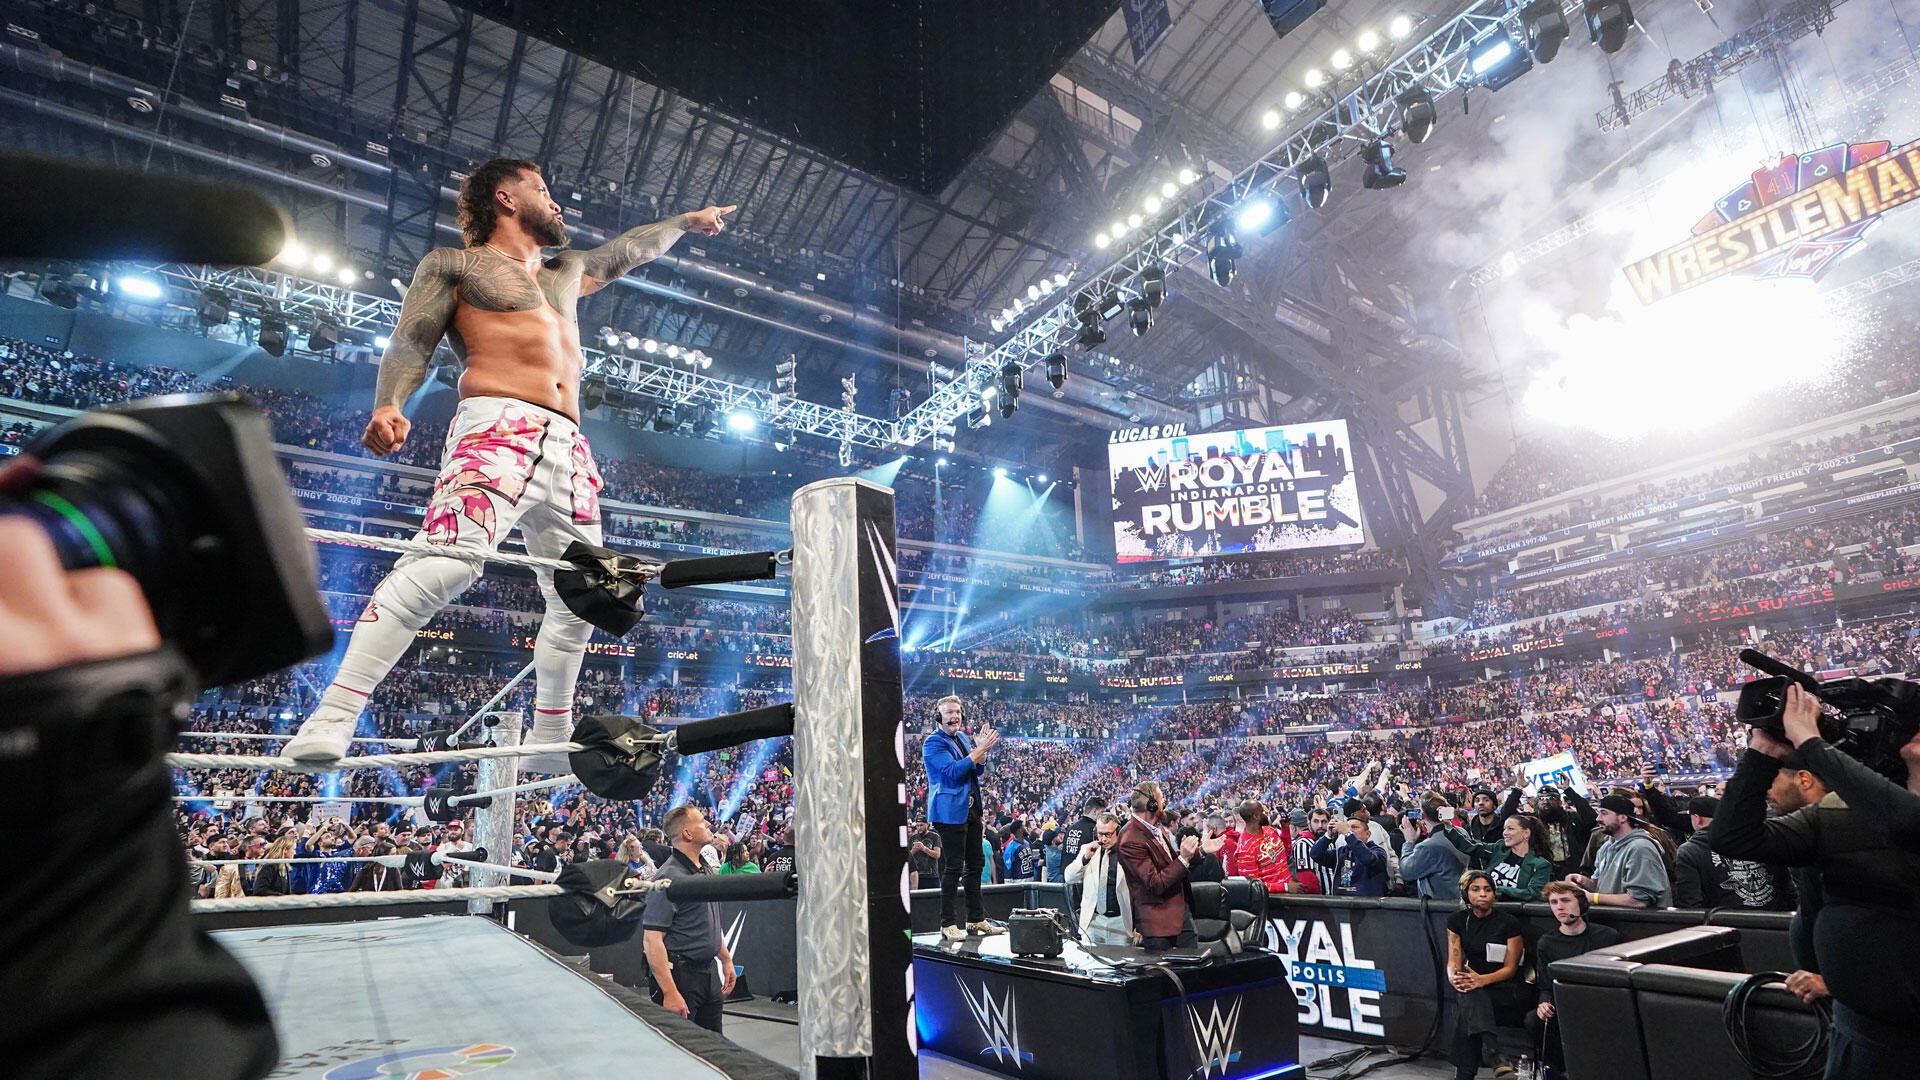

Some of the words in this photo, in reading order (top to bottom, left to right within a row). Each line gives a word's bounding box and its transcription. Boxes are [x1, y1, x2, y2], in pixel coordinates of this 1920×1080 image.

[1109, 425, 1161, 443] LUCAS
[1162, 423, 1187, 438] OIL
[1169, 449, 1321, 492] ROYAL
[1727, 479, 1763, 494] DWIGHT
[1766, 466, 1811, 485] FREENEY
[1817, 455, 1857, 471] 2002-12
[1170, 481, 1295, 502] INDIANAPOLIS
[327, 494, 362, 506] 2002-08
[1142, 489, 1328, 536] RUMBLE
[1587, 515, 1616, 529] ROBERT
[1616, 509, 1646, 522] MATHIS
[607, 536, 632, 546] JAMES
[634, 539, 661, 549] 1999-05
[702, 547, 719, 556] ERIC
[1477, 547, 1497, 559] TARIK
[1498, 541, 1521, 553] GLENN
[927, 573, 941, 581] JEFF
[942, 574, 969, 584] SATURDAY
[416, 629, 455, 640] cricket
[1596, 626, 1628, 639] cricket
[584, 642, 636, 657] UMBLE
[1470, 646, 1511, 661] ROYAL
[1512, 635, 1565, 654] RUMBLE
[667, 651, 698, 660] cricket
[1282, 667, 1320, 679] ROYAL
[1322, 663, 1369, 676] RUMBLE
[1395, 661, 1422, 671] cricket
[948, 668, 983, 680] ROYAL
[985, 669, 1025, 682] RUMBLE
[1047, 675, 1068, 683] cricket
[1107, 678, 1138, 688] ROYAL
[1140, 675, 1184, 687] RUMBLE
[1208, 673, 1234, 682] cricket
[1069, 829, 1082, 838] CSC
